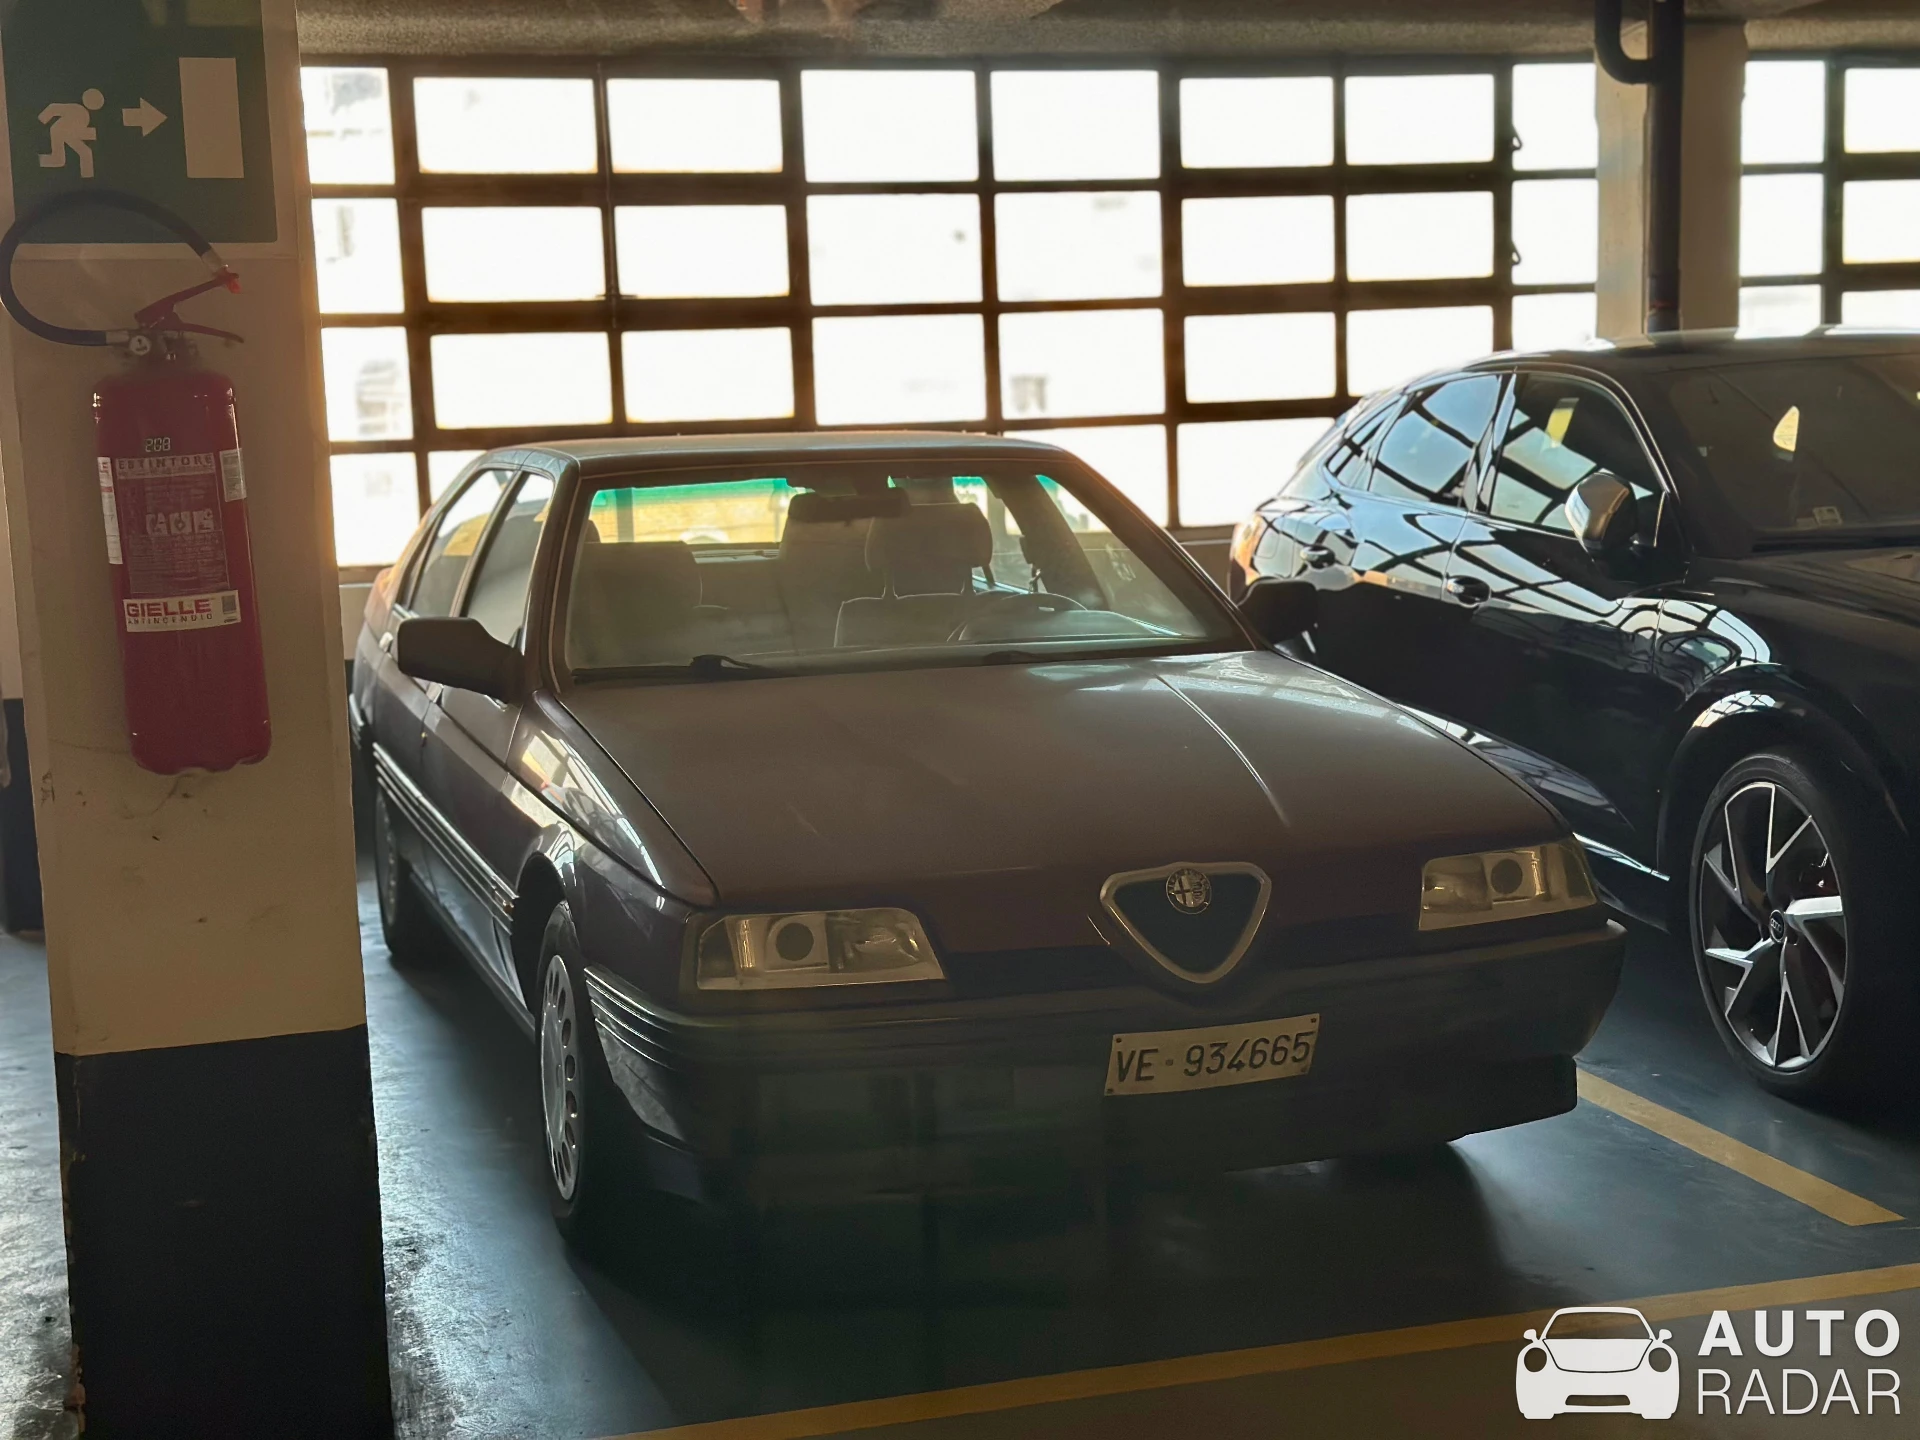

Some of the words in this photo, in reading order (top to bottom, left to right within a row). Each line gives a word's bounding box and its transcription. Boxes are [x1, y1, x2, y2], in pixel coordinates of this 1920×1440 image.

[126, 599, 211, 618] GIELLE
[1116, 1048, 1159, 1083] VE
[1183, 1031, 1316, 1077] 934665
